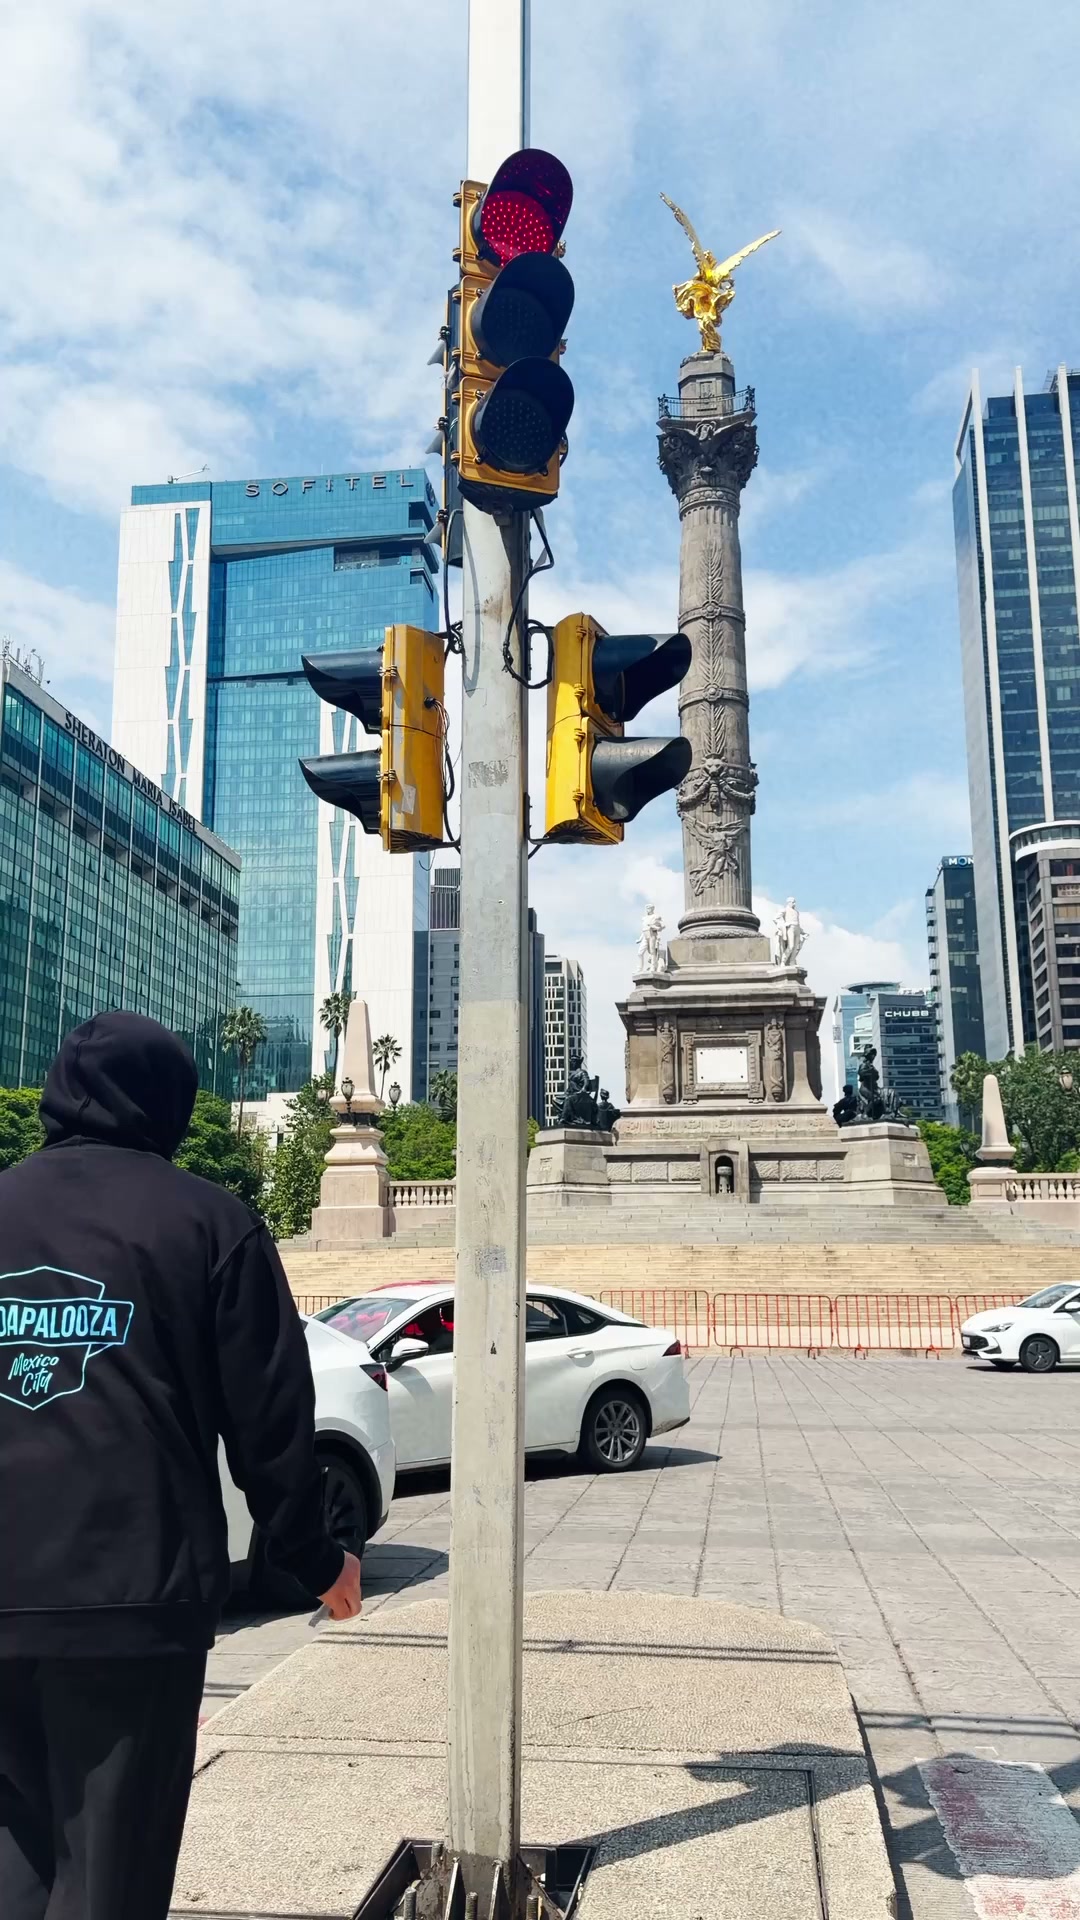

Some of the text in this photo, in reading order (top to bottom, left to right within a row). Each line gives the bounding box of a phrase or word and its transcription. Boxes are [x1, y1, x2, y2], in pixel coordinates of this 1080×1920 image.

[245, 473, 414, 498] SOFITEL
[65, 711, 197, 834] SHERATON MARIA ISABEL
[884, 1010, 929, 1018] CHUBB
[8, 1353, 60, 1380] Mexico
[22, 1368, 53, 1397] City
